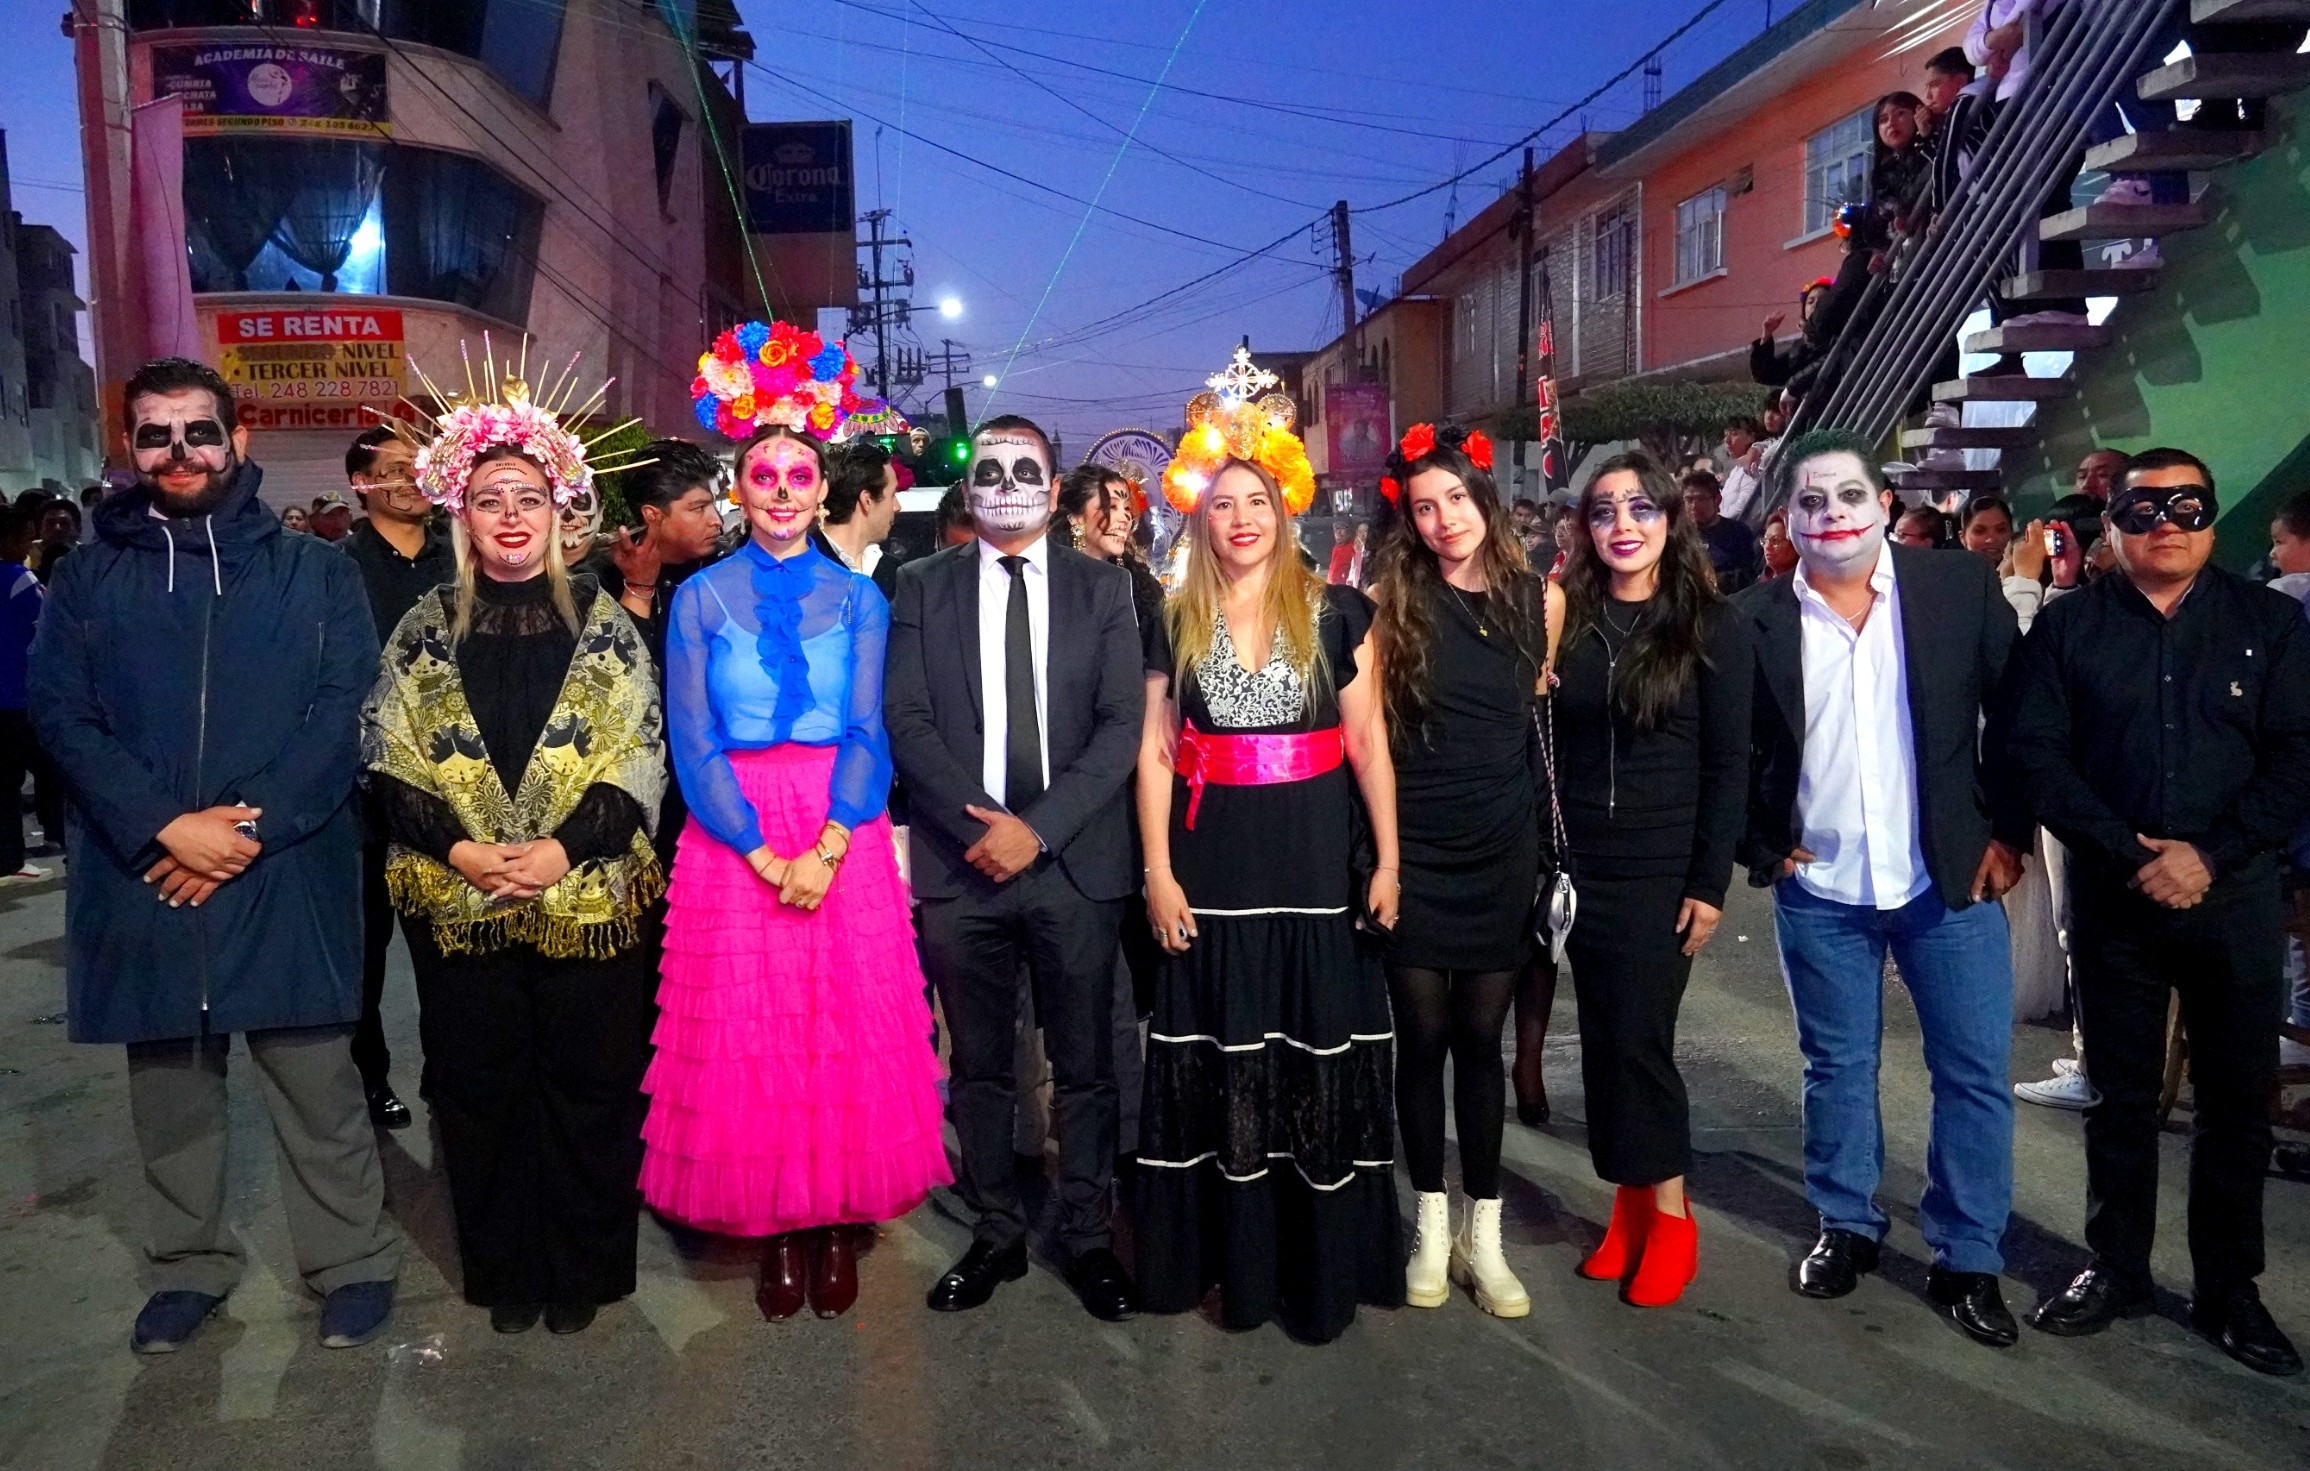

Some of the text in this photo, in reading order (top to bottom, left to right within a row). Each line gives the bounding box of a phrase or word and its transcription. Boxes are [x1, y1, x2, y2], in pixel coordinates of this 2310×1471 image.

[194, 48, 345, 70] ACADEMIA DE BAILE
[745, 163, 840, 193] Corona
[238, 316, 381, 337] SE RENTA
[342, 343, 400, 359] NIVEL
[247, 361, 393, 380] TERCER NIVEL
[232, 380, 399, 399] Tel. 248 228 7821
